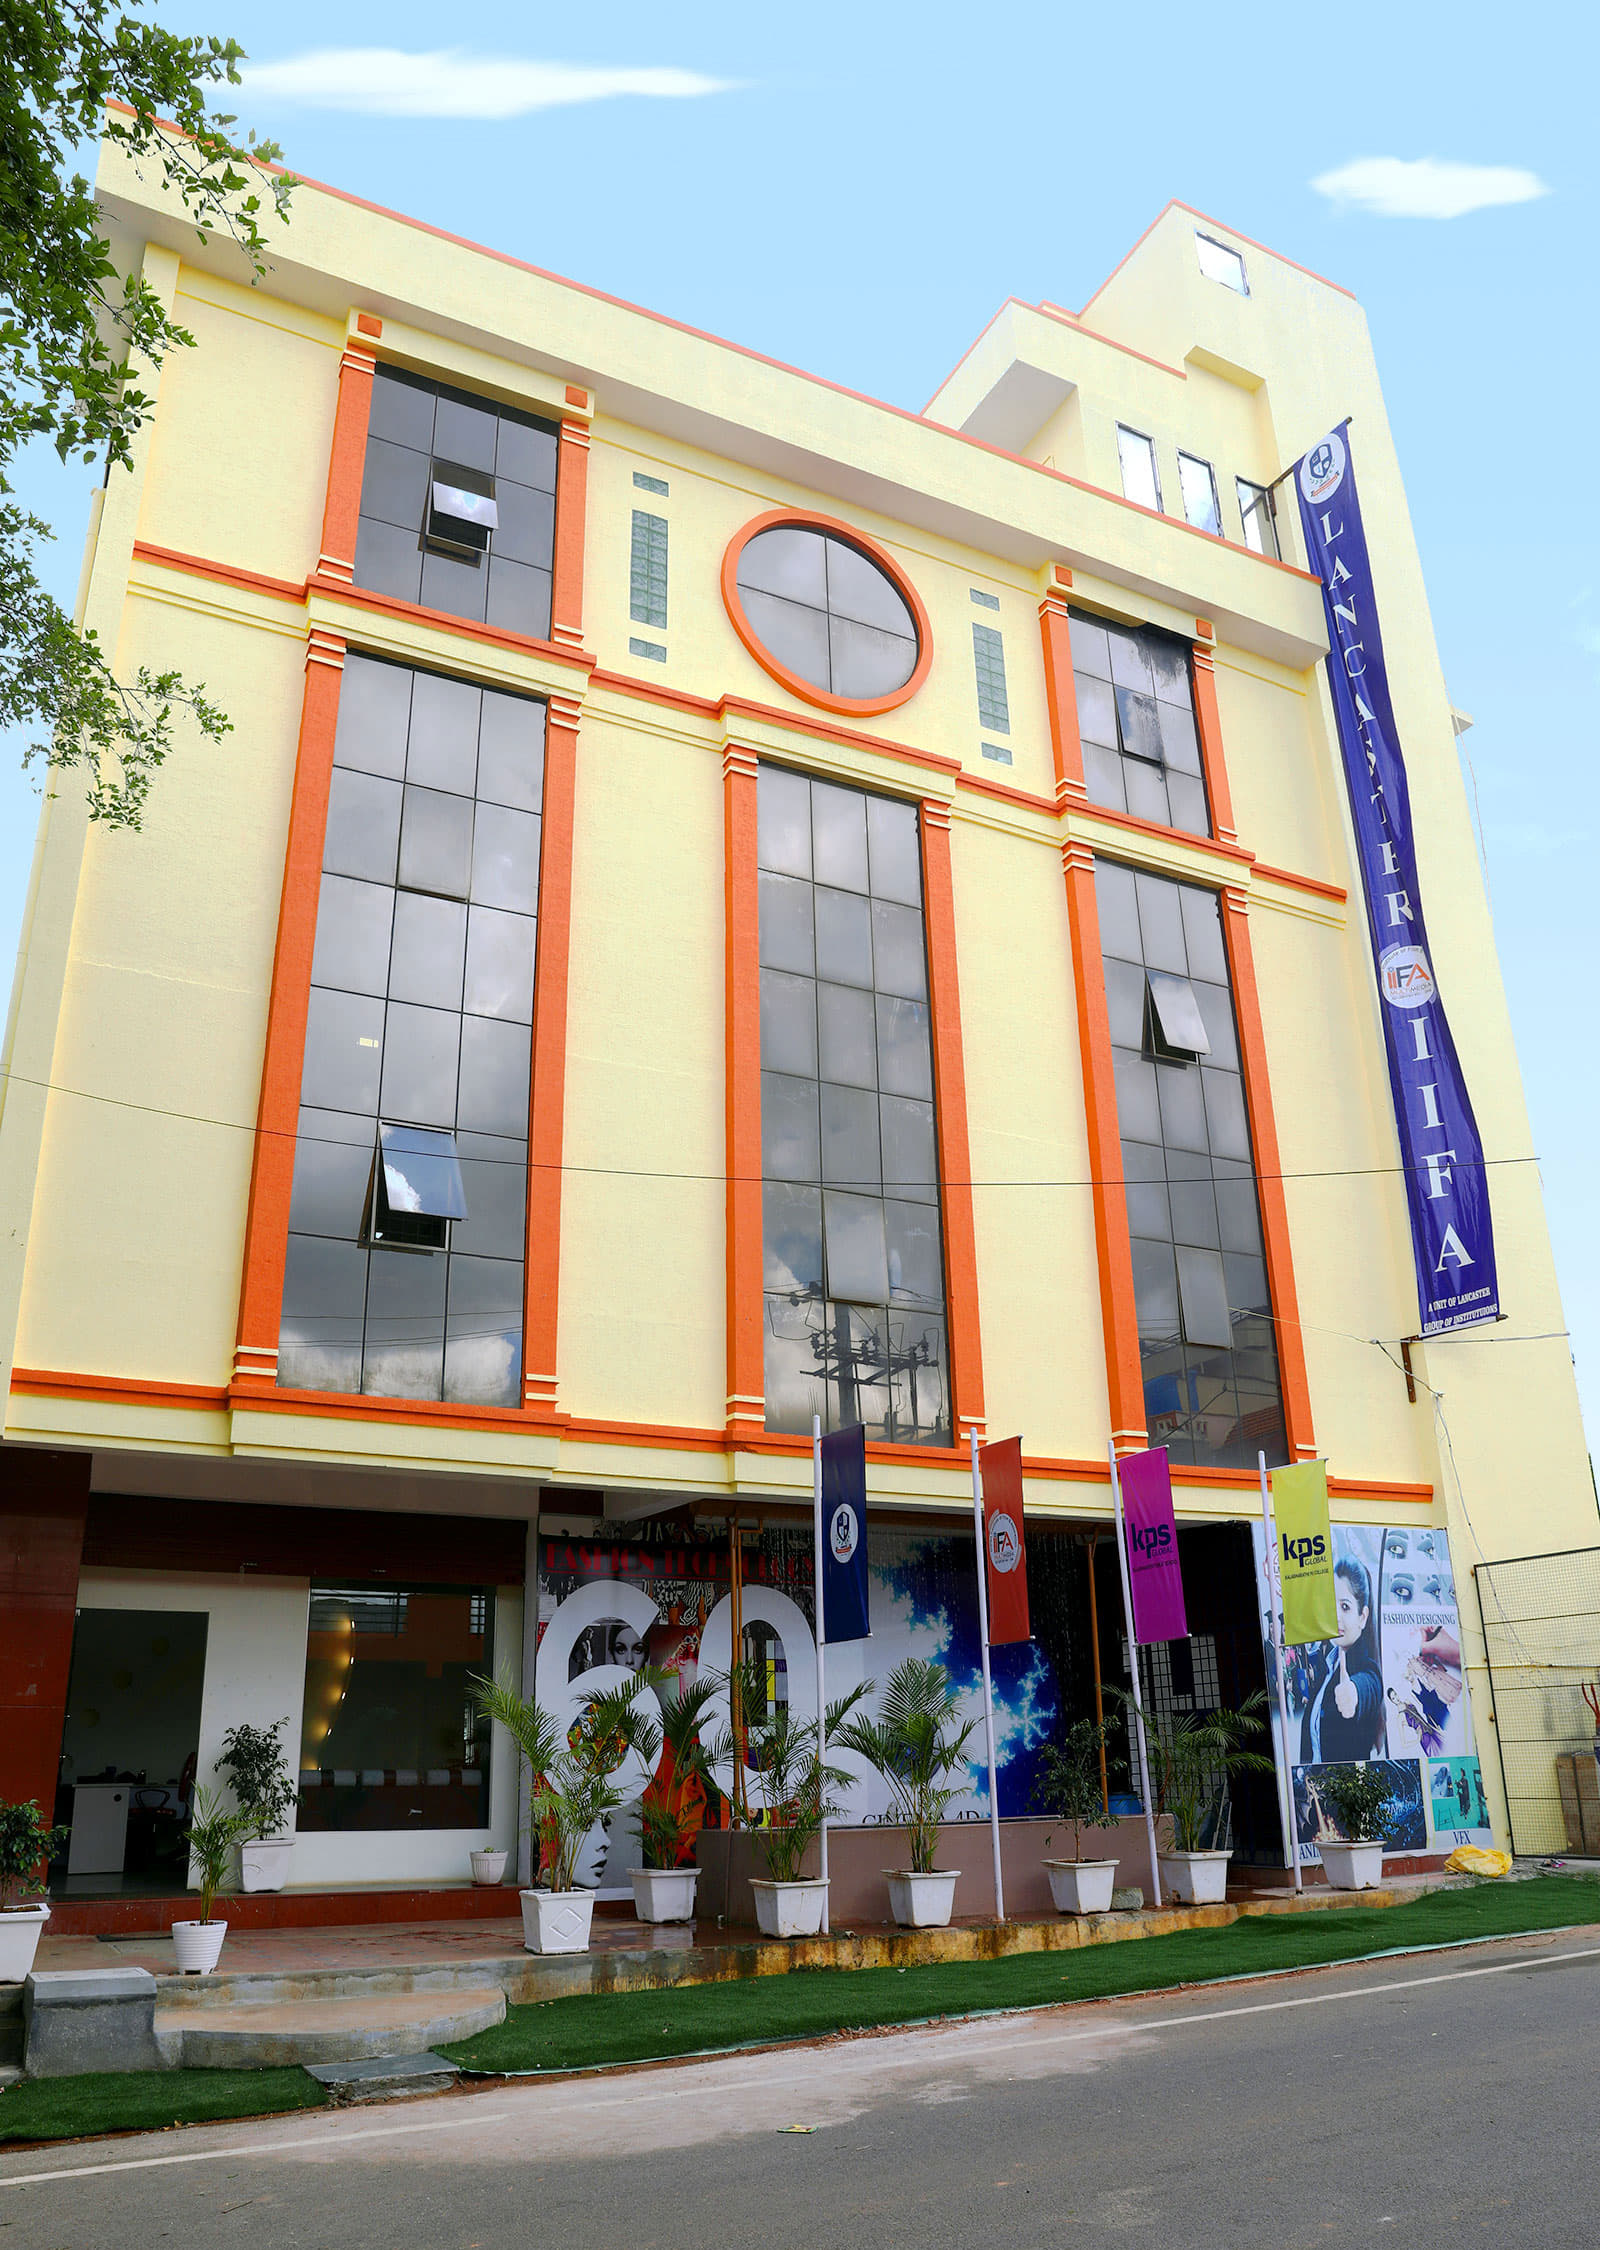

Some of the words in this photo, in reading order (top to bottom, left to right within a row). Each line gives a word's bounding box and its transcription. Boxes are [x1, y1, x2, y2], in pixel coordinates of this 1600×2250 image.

[1407, 1015, 1476, 1274] IIFA
[1428, 1303, 1433, 1312] A
[1433, 1299, 1447, 1311] UNIT
[1447, 1296, 1457, 1307] OF
[1457, 1287, 1490, 1304] LANCASTER
[1424, 1320, 1443, 1332] GROUP
[1444, 1316, 1453, 1326] OF
[1131, 1522, 1172, 1560] kps
[1282, 1532, 1326, 1568] kps
[545, 1542, 655, 1573] FASHION
[1304, 1556, 1327, 1566] GLOBAL
[1383, 1613, 1415, 1624] FASHION
[1416, 1613, 1456, 1624] DESIGNING
[1452, 1831, 1472, 1844] VFX
